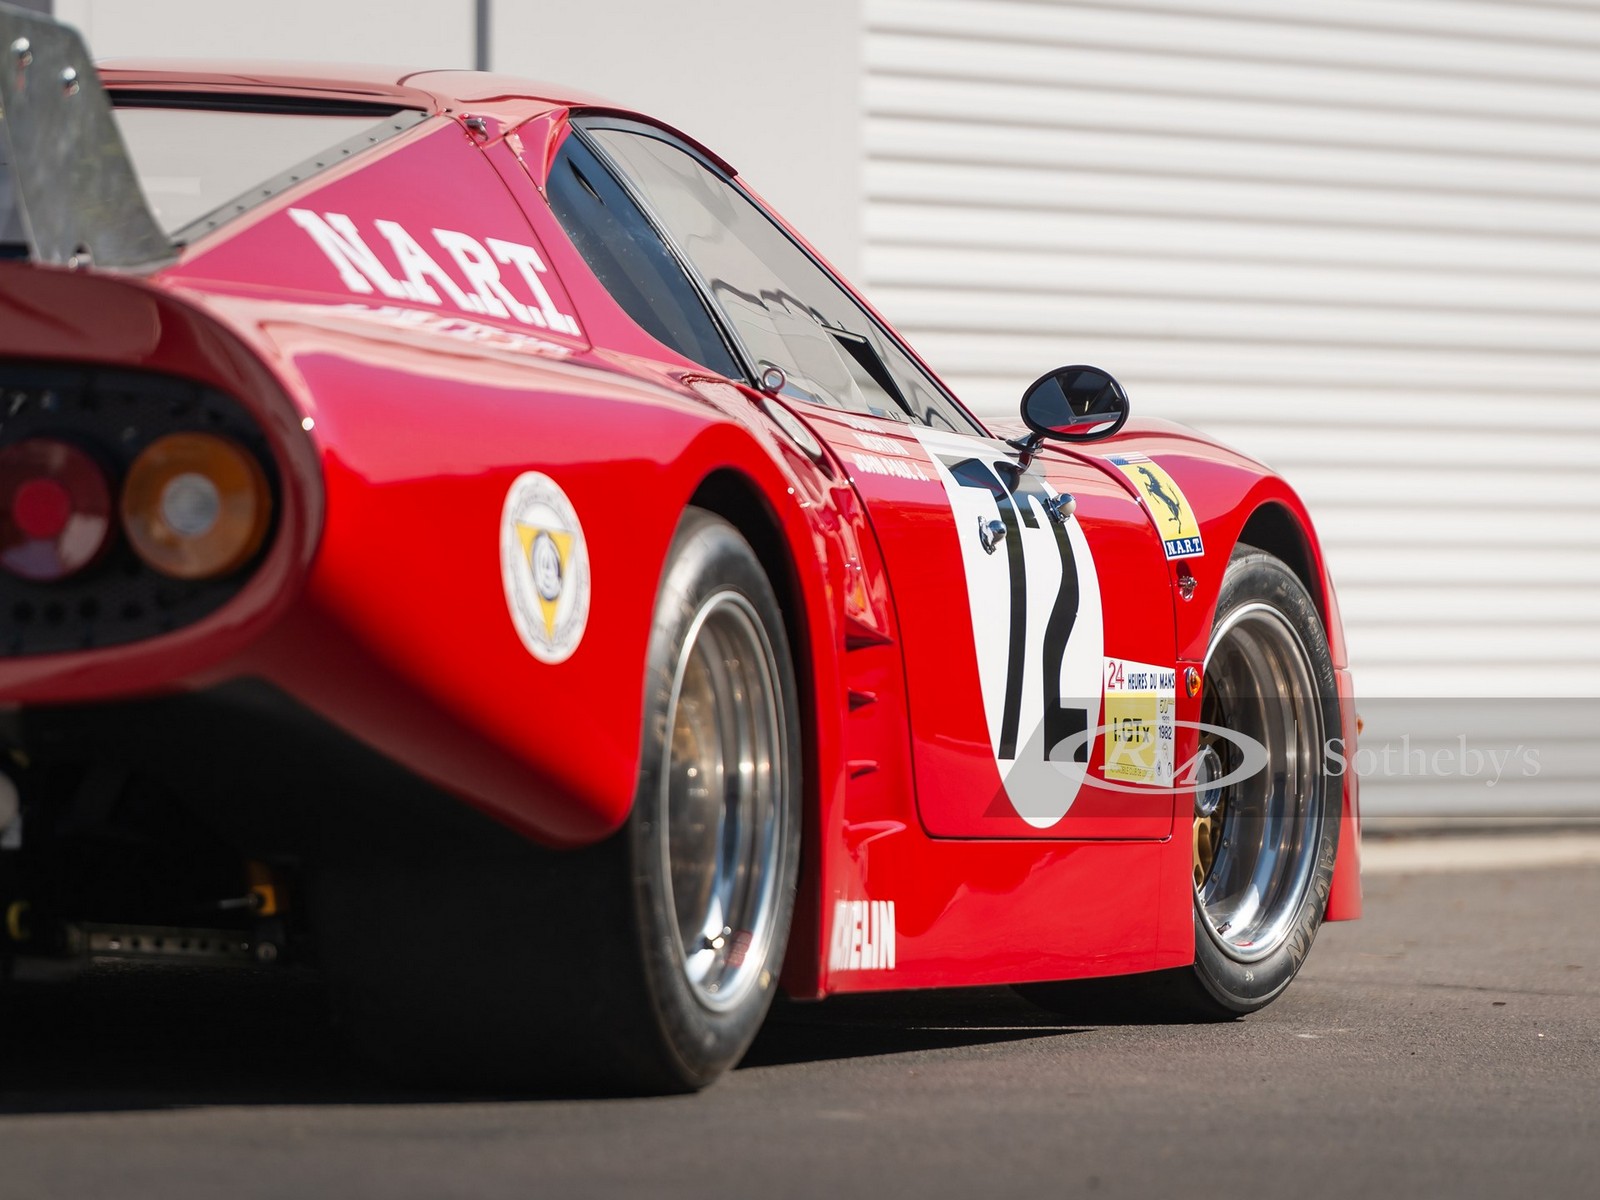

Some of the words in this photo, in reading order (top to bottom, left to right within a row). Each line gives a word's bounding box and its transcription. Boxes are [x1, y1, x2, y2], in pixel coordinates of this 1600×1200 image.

[879, 457, 919, 480] PAUL
[935, 453, 1089, 763] 72
[1107, 661, 1125, 690] 24
[1127, 672, 1148, 690] HEURES
[1149, 673, 1158, 690] DU
[1159, 672, 1175, 690] MANS
[1158, 725, 1173, 740] 1982
